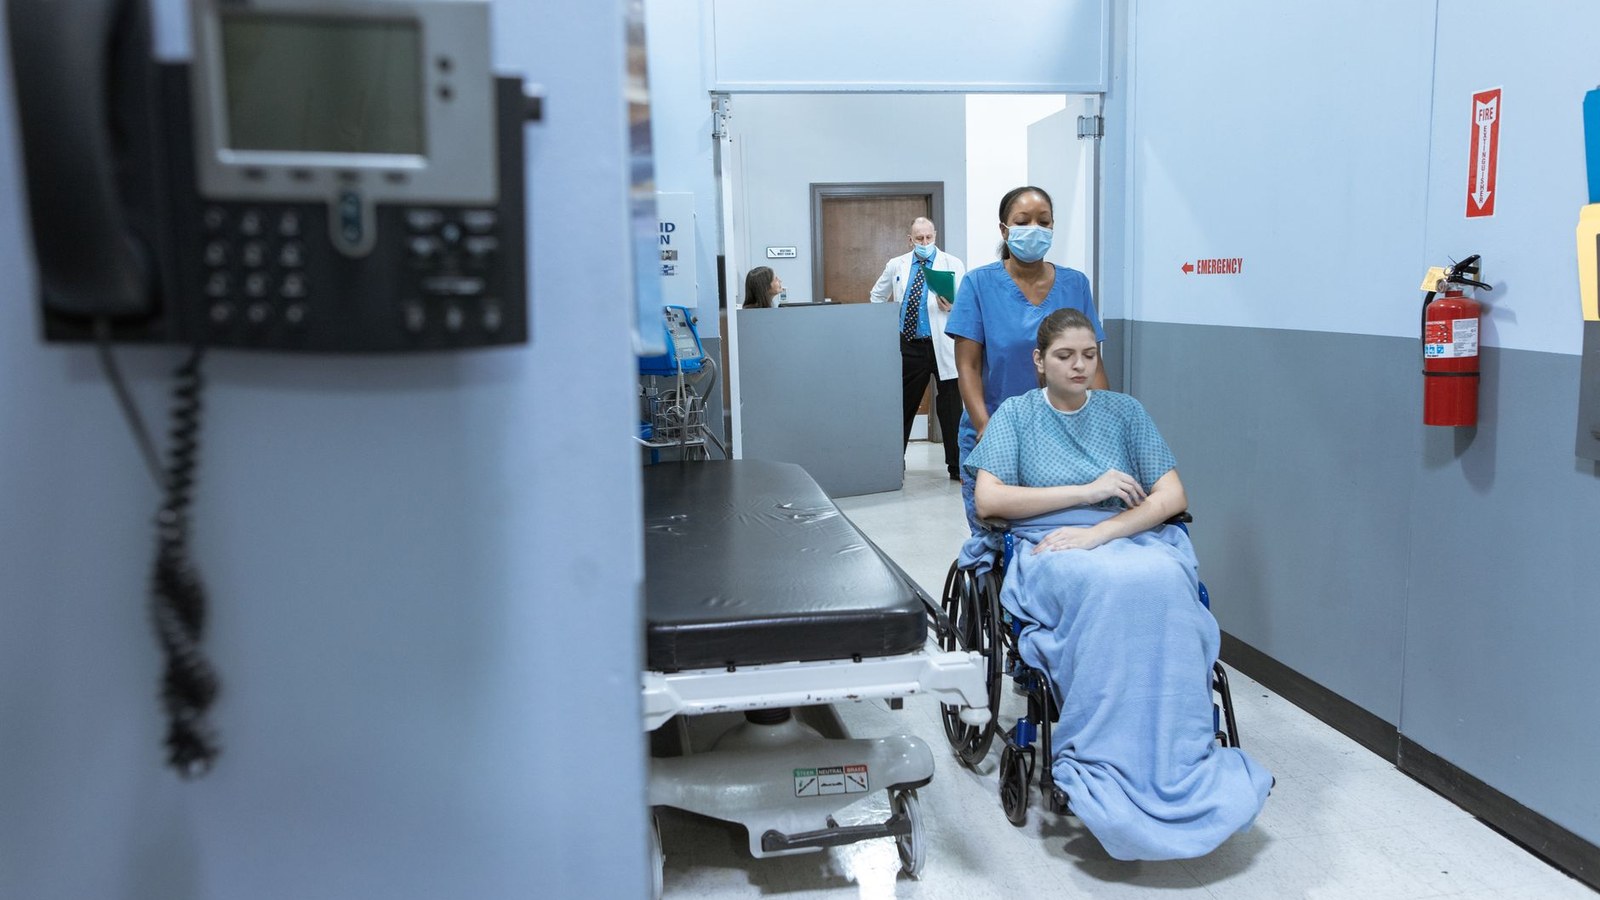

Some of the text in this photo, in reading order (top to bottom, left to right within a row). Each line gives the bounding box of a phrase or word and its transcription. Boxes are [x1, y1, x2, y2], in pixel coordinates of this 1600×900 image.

[1478, 107, 1494, 121] FIRE
[1197, 258, 1243, 274] EMERGENCY
[818, 768, 843, 776] NEUTRAL
